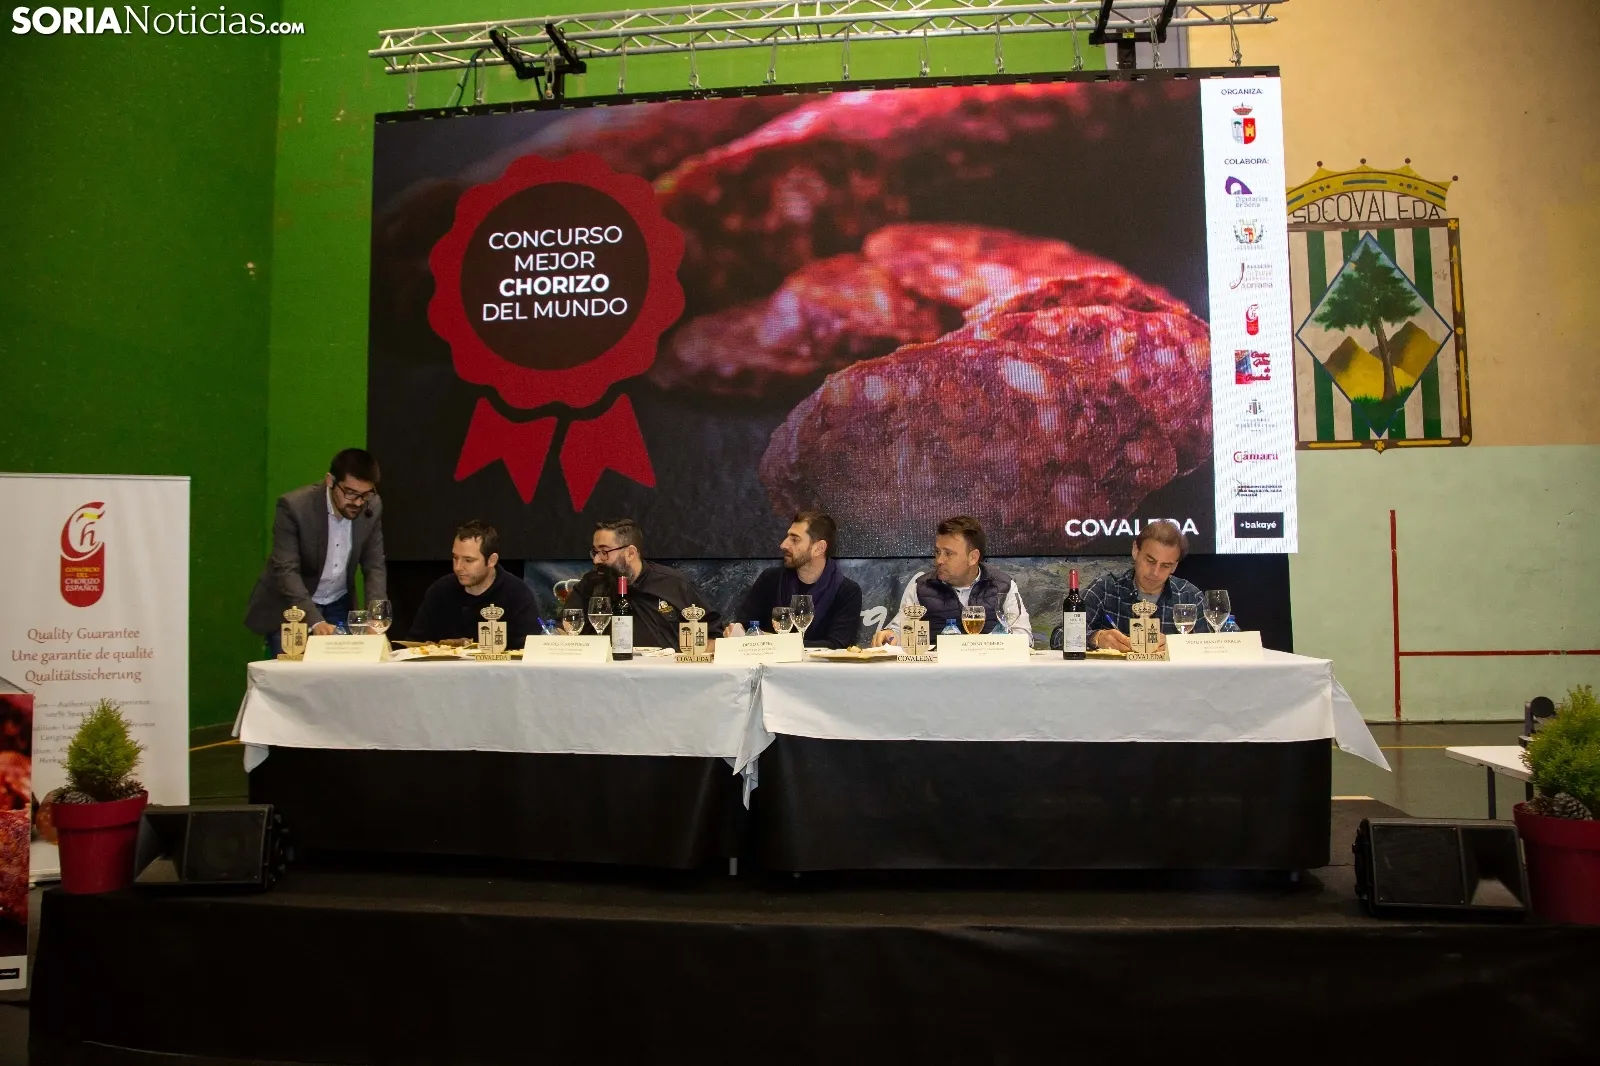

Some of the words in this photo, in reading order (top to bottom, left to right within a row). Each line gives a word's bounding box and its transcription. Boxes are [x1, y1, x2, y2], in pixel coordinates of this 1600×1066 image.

[488, 225, 623, 250] CONCURSO
[514, 251, 596, 272] MEJOR
[499, 273, 610, 297] CHORIZO
[482, 302, 528, 321] DEL
[533, 297, 628, 319] MUNDO
[1064, 518, 1199, 537] COVALA
[27, 627, 73, 643] Quality
[77, 628, 140, 639] Guarantee
[12, 650, 38, 661] Une
[41, 648, 92, 664] garantie
[95, 647, 110, 659] de
[113, 646, 154, 663] qualité
[25, 667, 142, 685] Qualitätssicherung
